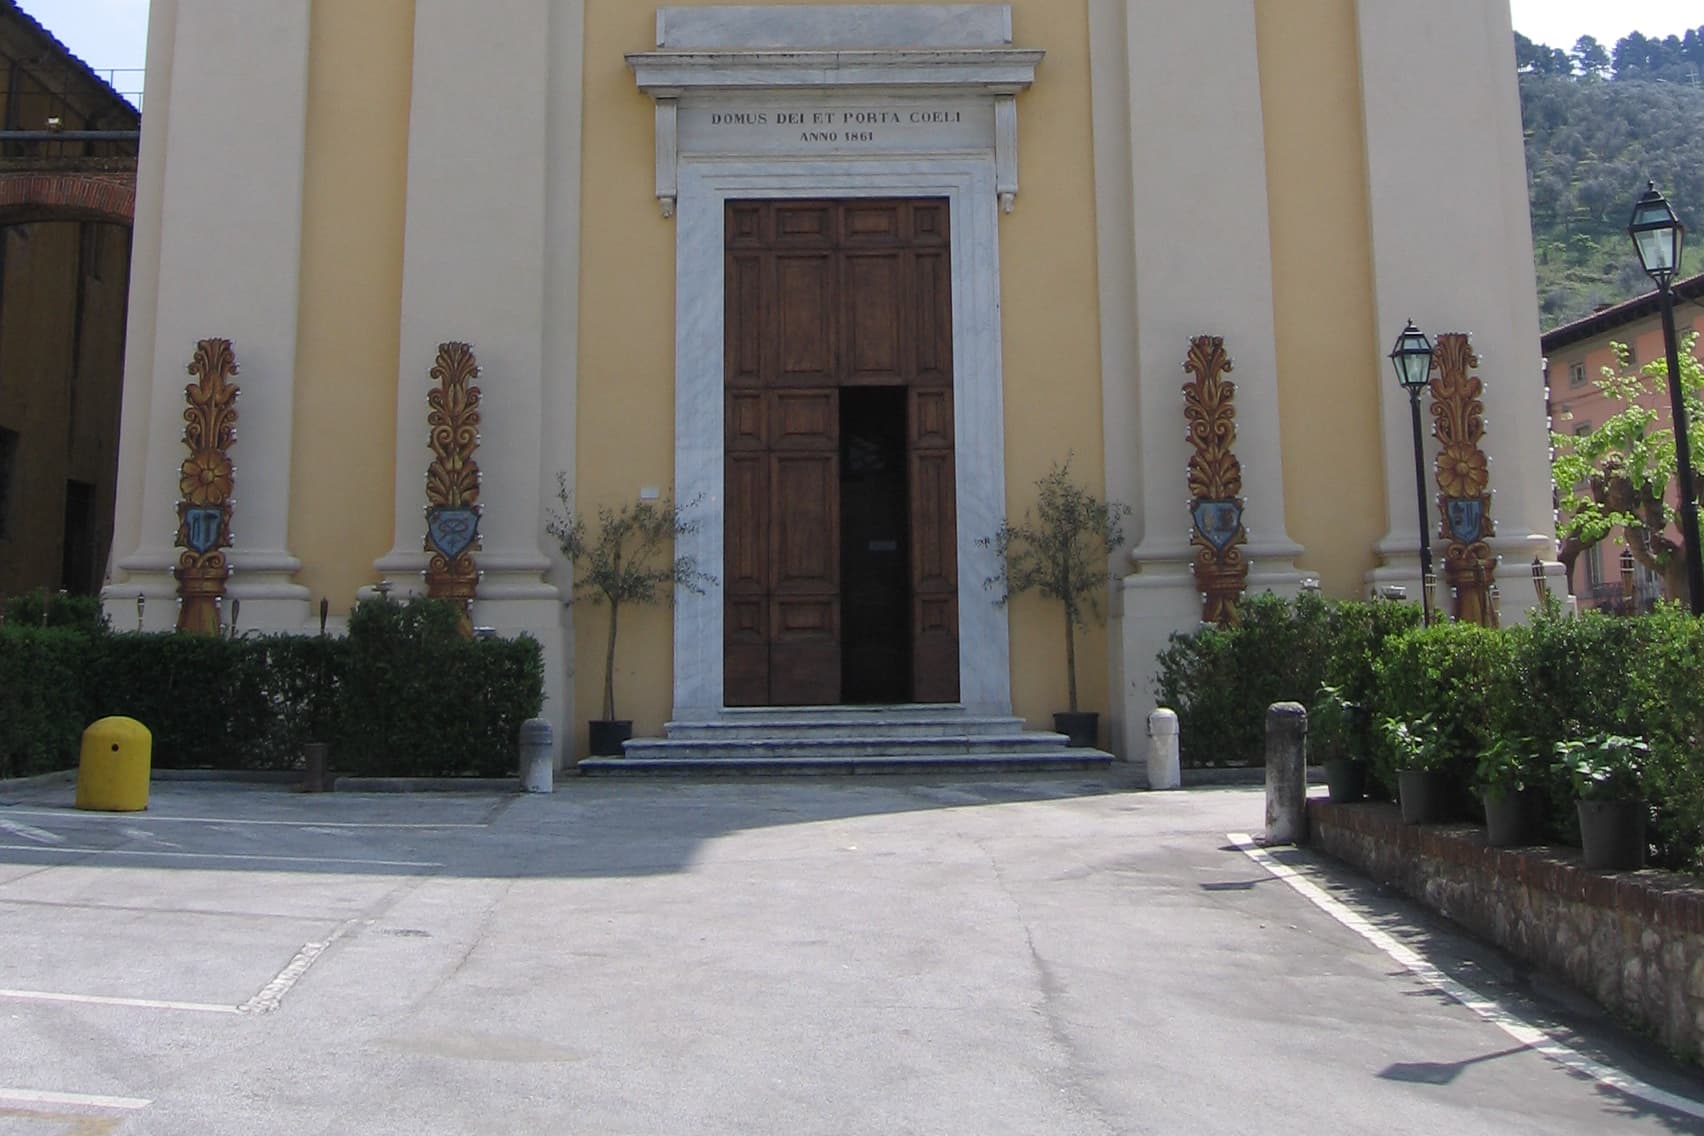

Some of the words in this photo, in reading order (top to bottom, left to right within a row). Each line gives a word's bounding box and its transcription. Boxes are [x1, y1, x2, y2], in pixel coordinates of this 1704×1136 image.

[712, 113, 767, 125] DOMUS
[777, 113, 804, 124] DEI
[813, 112, 833, 124] ET
[844, 111, 900, 124] PORTA
[910, 111, 961, 123] COELI
[800, 131, 837, 142] ANNO
